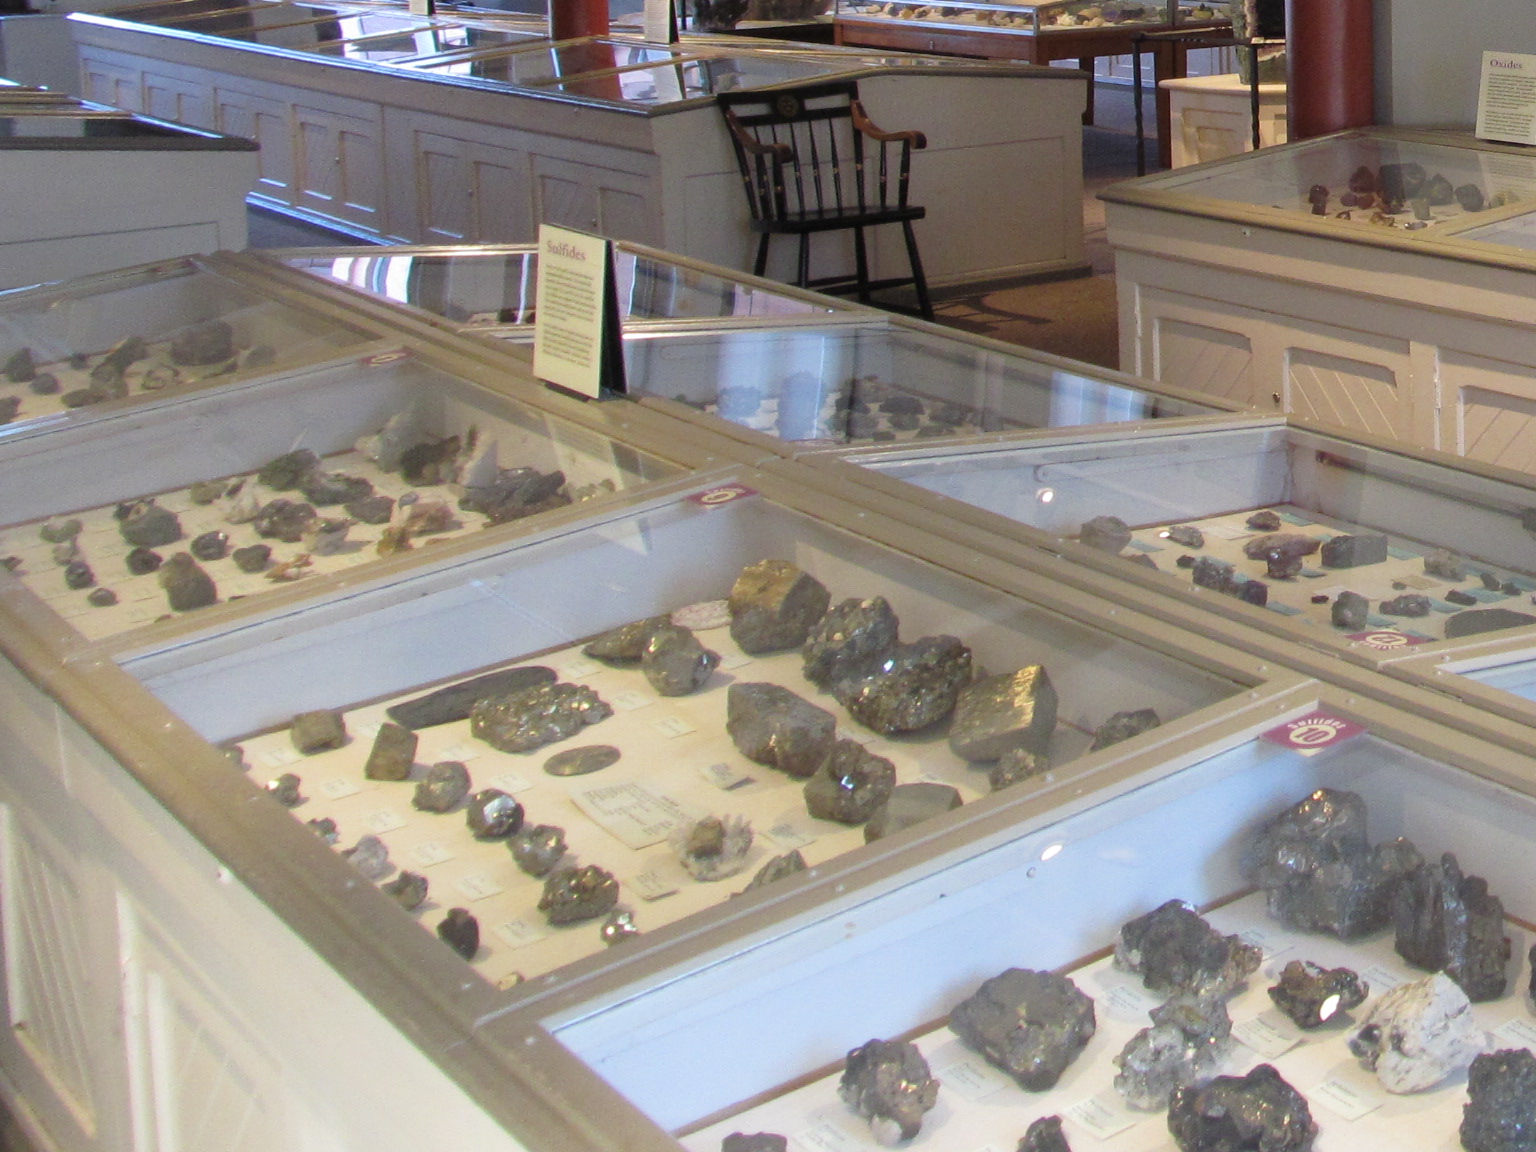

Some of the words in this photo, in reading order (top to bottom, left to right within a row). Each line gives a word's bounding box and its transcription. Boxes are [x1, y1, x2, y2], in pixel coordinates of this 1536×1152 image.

[1489, 58, 1523, 69] Oxides
[546, 240, 586, 262] Sulfides
[1286, 718, 1347, 729] Sulfides
[1293, 727, 1331, 743] 10
